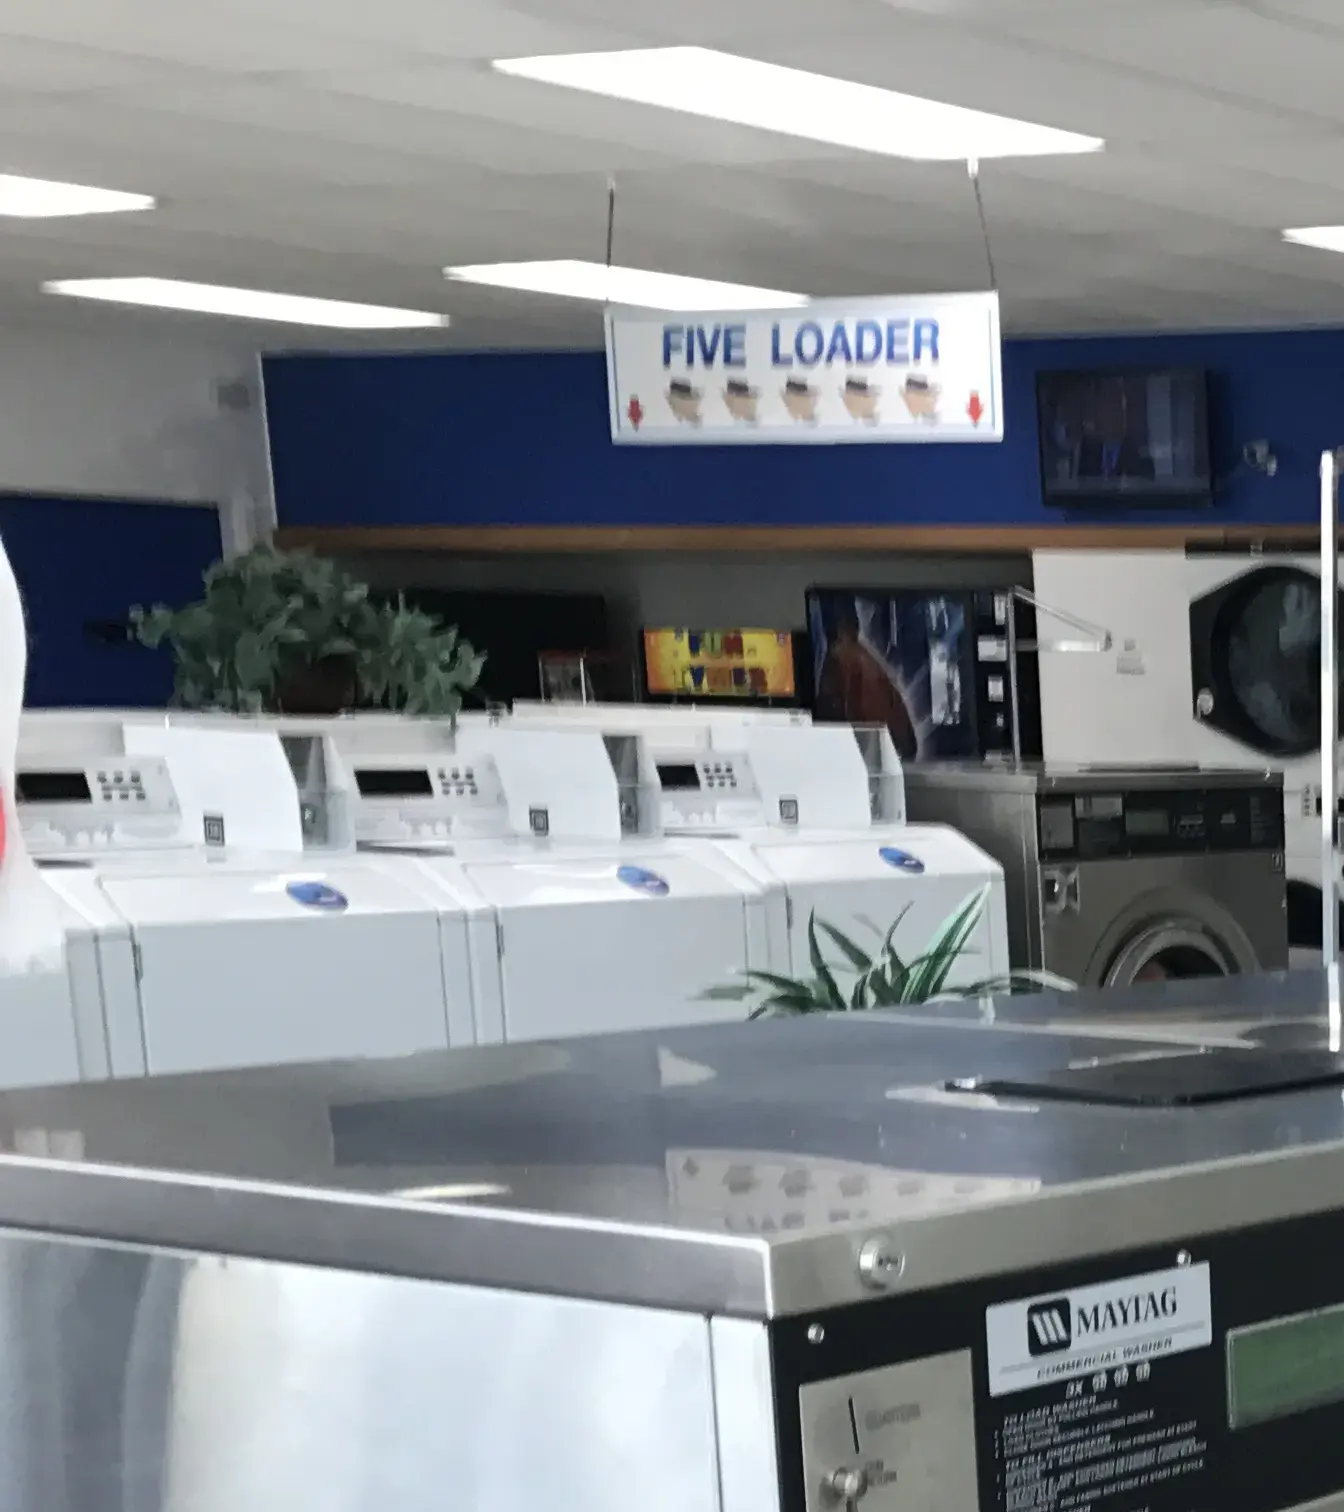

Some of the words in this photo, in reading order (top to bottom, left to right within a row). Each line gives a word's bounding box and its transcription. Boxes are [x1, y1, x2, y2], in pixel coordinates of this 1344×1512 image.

[663, 323, 746, 369] FIVE
[772, 319, 939, 368] LOADER
[1077, 1286, 1177, 1338] MAYTAG
